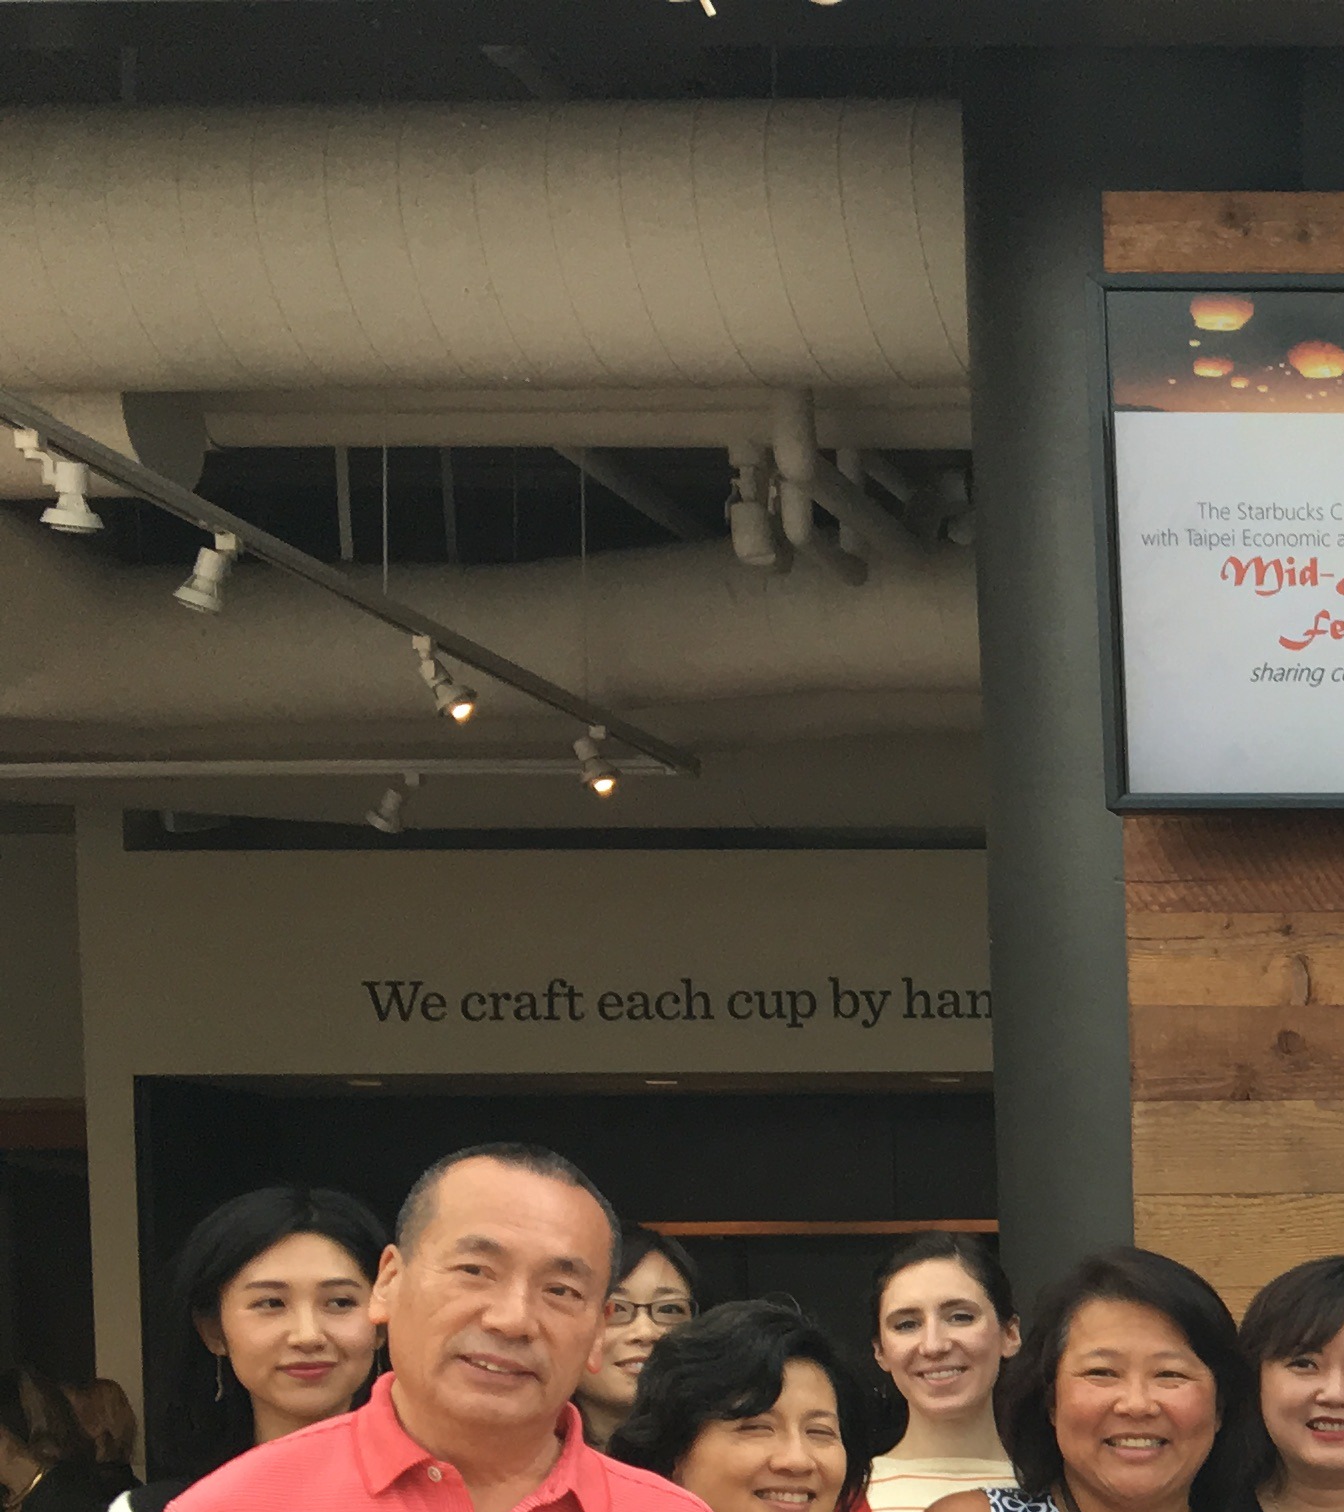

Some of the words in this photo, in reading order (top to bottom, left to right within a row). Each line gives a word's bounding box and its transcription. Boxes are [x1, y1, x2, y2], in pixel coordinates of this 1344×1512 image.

[1198, 502, 1230, 521] The
[1237, 502, 1324, 521] Starbucks
[1141, 528, 1179, 547] with
[1186, 528, 1236, 550] Taipei
[1242, 529, 1331, 548] Economic
[1250, 662, 1325, 688] sharing
[361, 980, 448, 1022] We
[460, 978, 585, 1022] craft
[597, 977, 715, 1022] each
[727, 989, 817, 1029] cup
[828, 977, 892, 1029] by
[901, 977, 992, 1019] han
